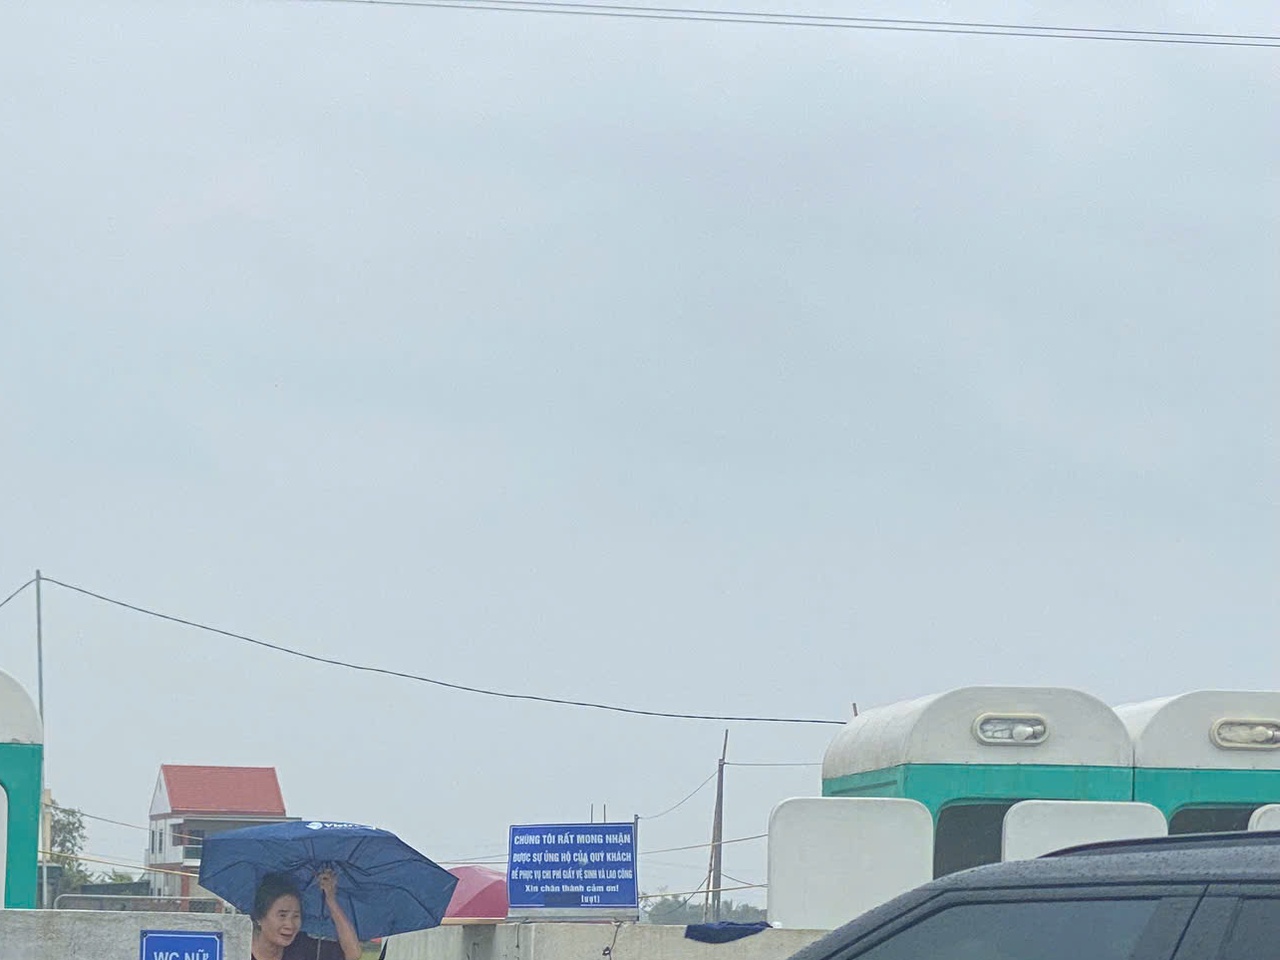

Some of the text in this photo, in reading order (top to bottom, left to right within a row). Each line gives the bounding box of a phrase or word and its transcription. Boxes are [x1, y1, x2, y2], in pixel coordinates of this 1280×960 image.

[514, 832, 631, 846] CHÚNG TÔI RẤT MONG NHẬN
[532, 852, 543, 864] SỰ
[560, 851, 571, 864] HỘ
[572, 850, 588, 862] CỦA
[589, 850, 605, 863] QUÝ
[606, 851, 632, 862] KHÁCH
[525, 884, 539, 892] Xin
[540, 884, 561, 892] chân
[561, 884, 585, 892] thành
